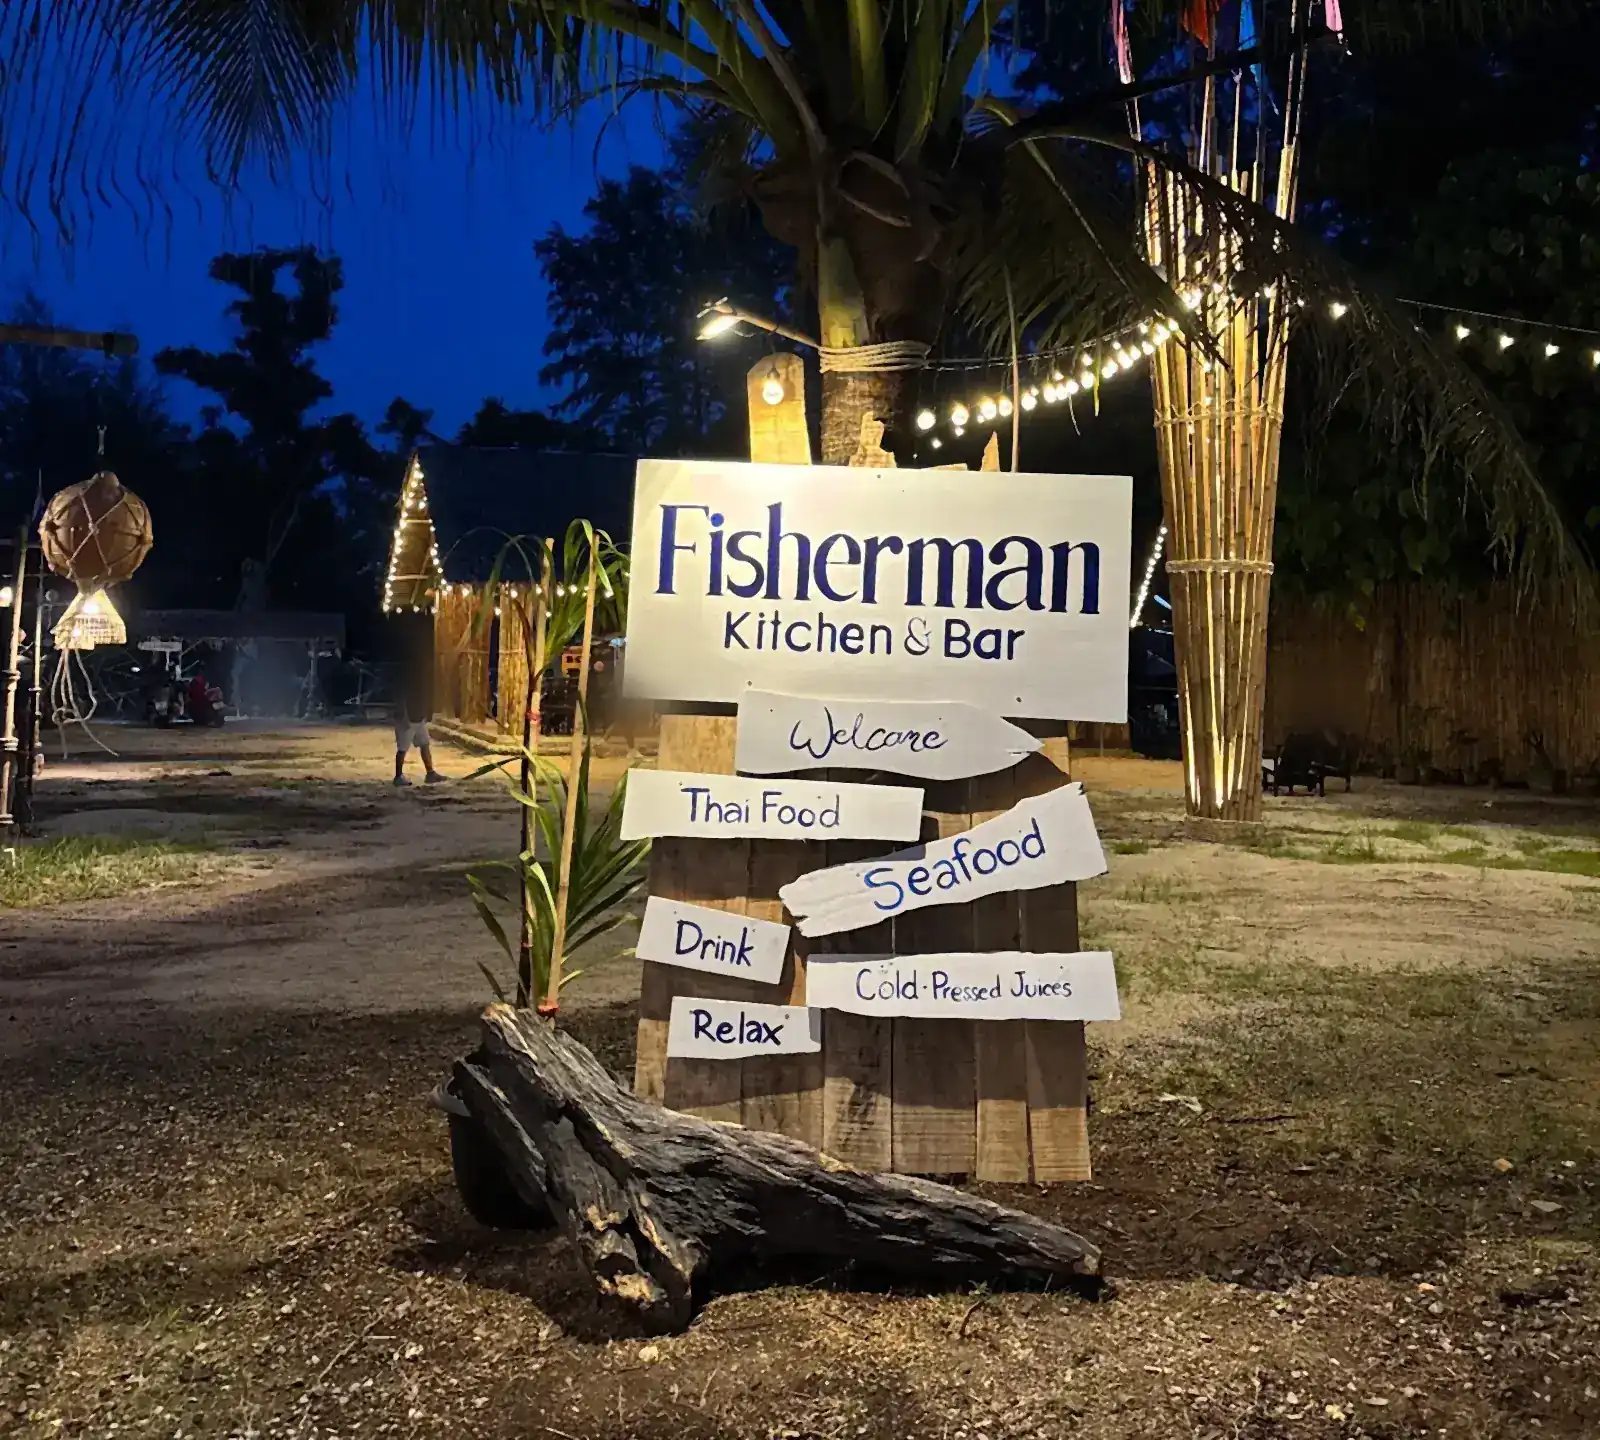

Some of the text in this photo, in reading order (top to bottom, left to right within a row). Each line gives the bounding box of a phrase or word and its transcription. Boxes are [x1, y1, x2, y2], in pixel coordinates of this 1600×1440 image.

[655, 502, 1100, 614] Fisherman
[724, 611, 1025, 660] Kitchen & Bar
[680, 787, 840, 828] Thai Food
[864, 818, 1046, 910] Seafood
[675, 919, 754, 967] Drink
[1010, 970, 1073, 998] Juices
[692, 1009, 784, 1046] Relax
